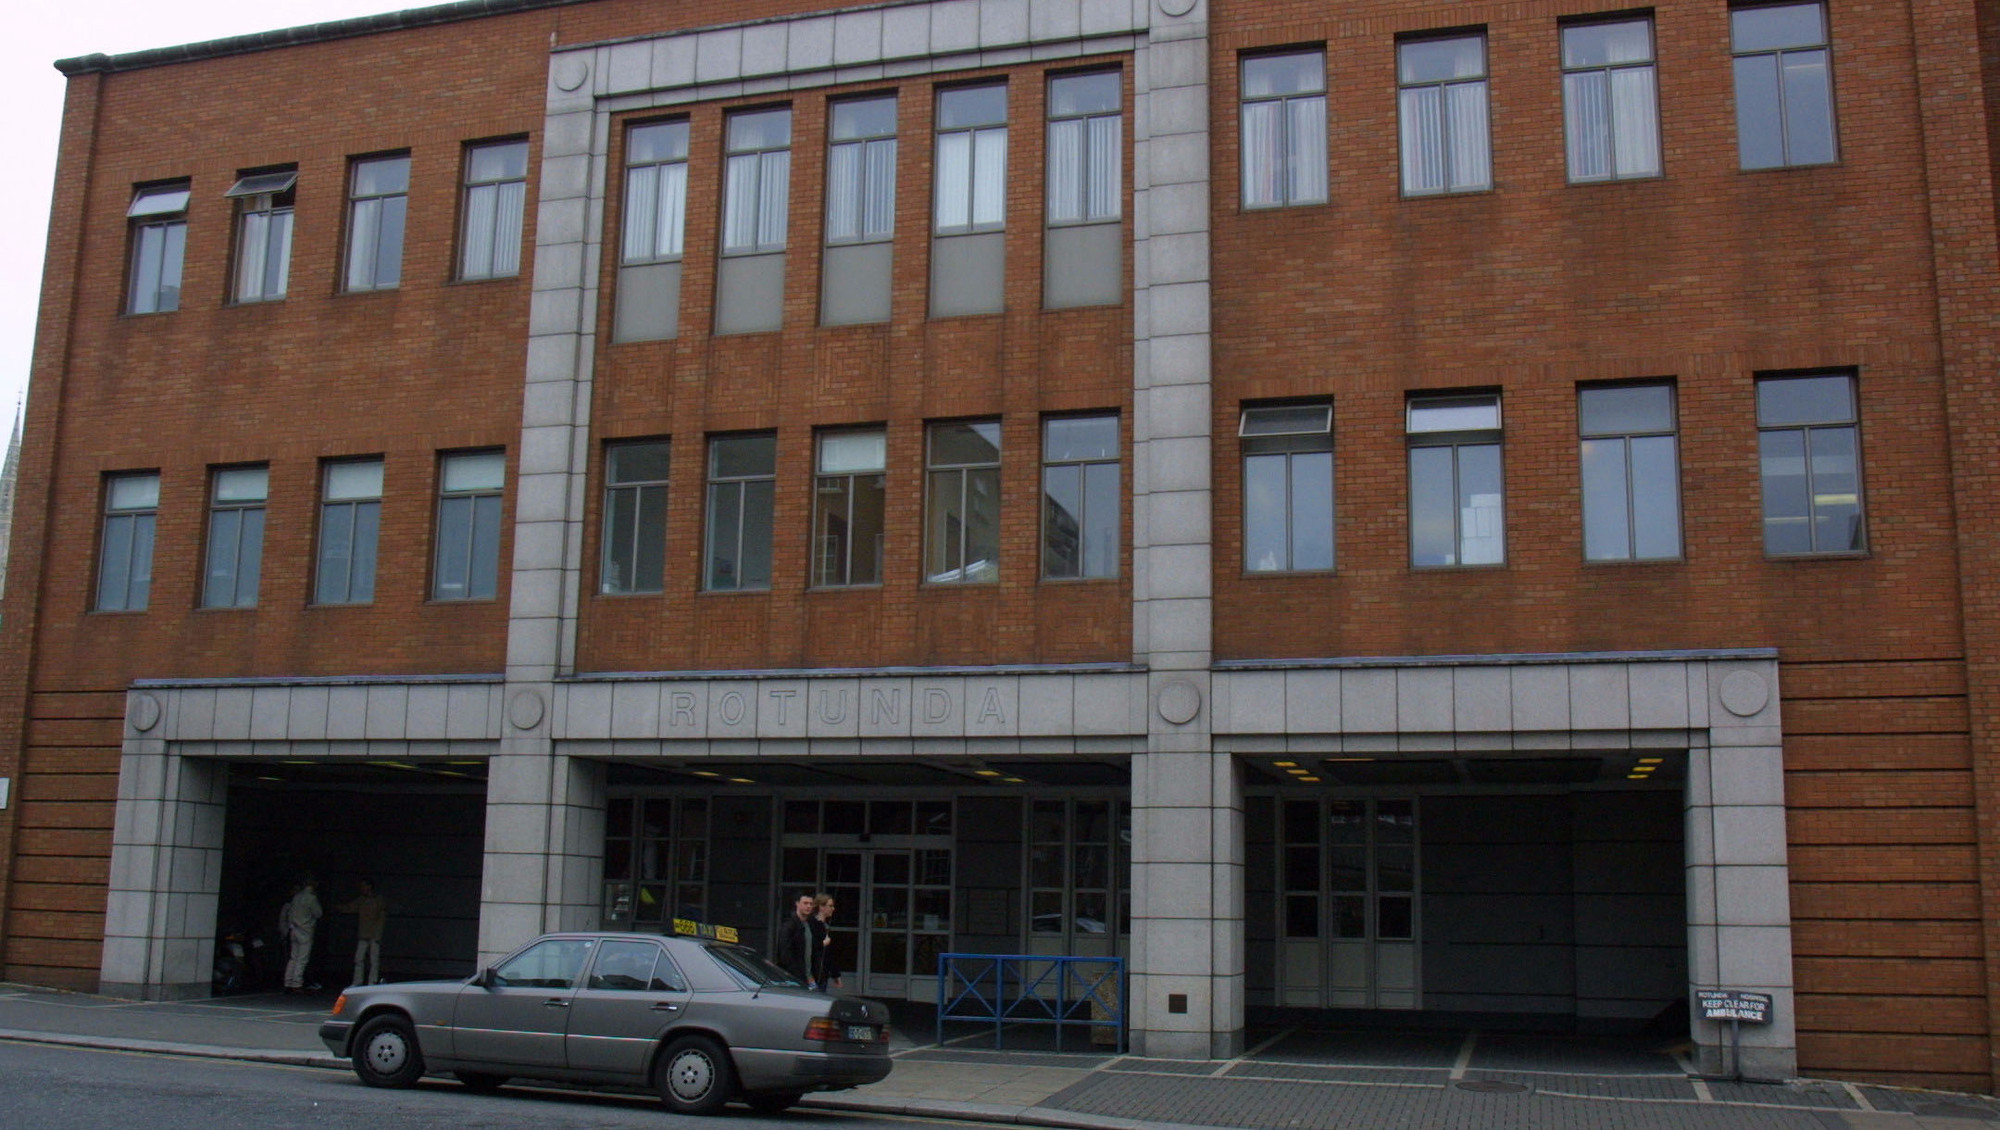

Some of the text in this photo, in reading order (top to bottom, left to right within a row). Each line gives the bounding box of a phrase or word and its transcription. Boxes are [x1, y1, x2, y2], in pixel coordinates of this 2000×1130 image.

[670, 686, 1006, 727] ROTUNDA
[1702, 1000, 1765, 1011] KEEP CLEAR FOR
[1706, 1009, 1763, 1020] AMBULANCE
